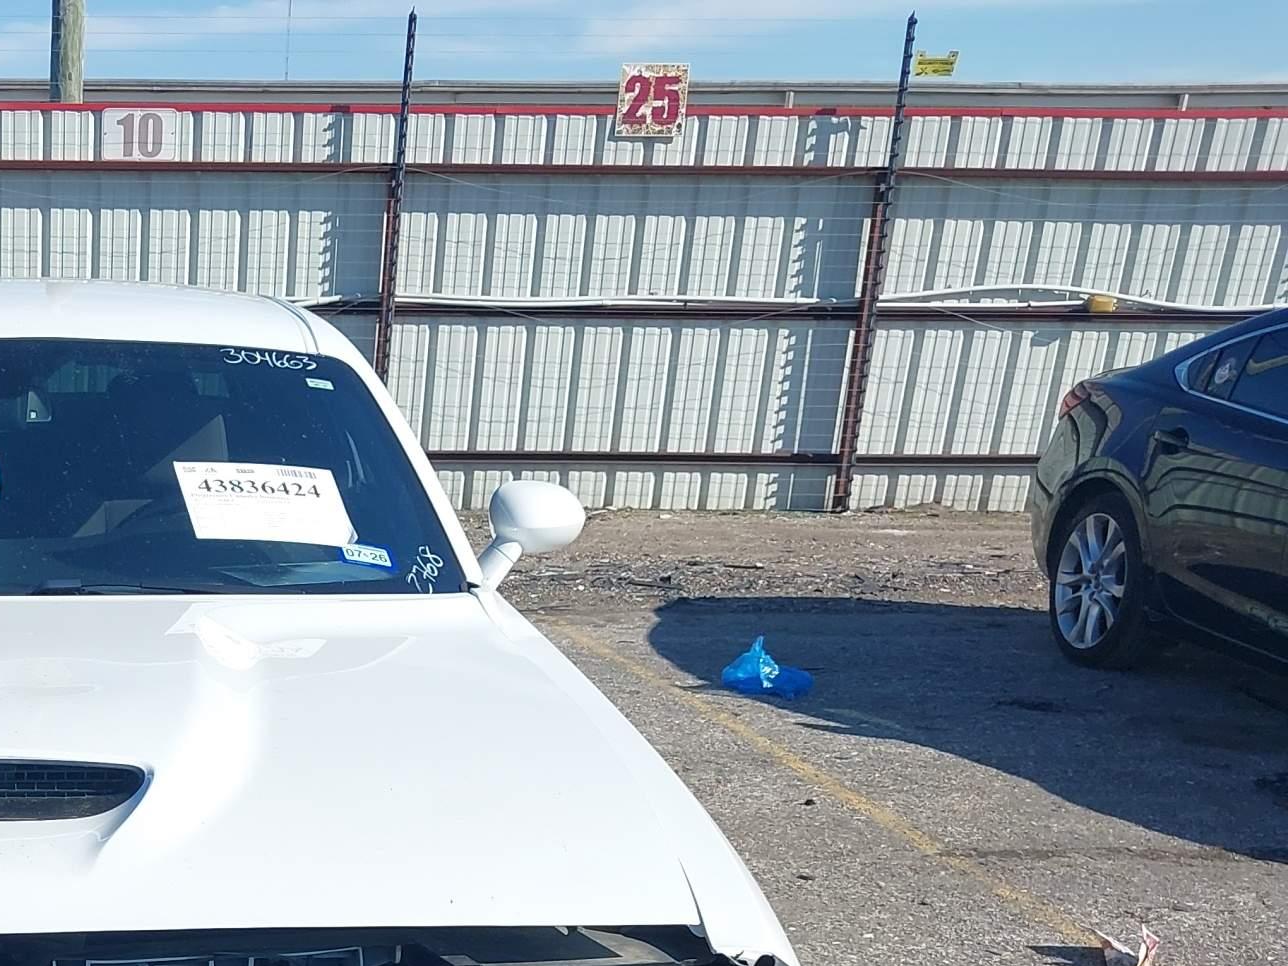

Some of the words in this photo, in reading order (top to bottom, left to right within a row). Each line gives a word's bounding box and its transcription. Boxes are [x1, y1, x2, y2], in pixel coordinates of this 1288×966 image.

[622, 75, 682, 125] 25
[116, 112, 163, 158] 10
[219, 347, 318, 370] 304663
[198, 478, 321, 499] 43836424
